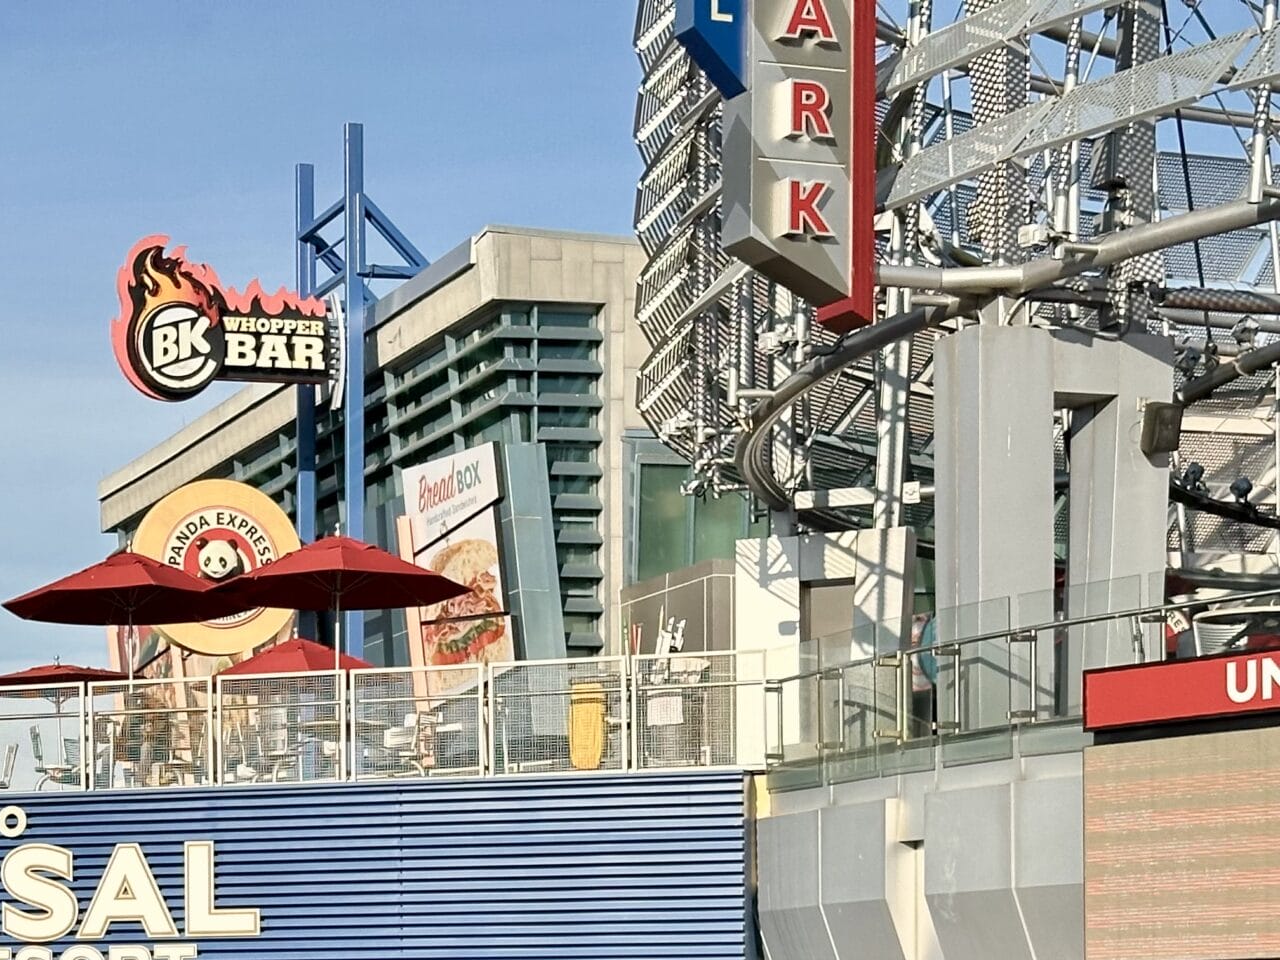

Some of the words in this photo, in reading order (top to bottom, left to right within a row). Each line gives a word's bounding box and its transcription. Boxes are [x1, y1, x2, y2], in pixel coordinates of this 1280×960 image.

[152, 316, 211, 368] BK
[222, 316, 324, 335] WHOPPER
[224, 333, 325, 370] BAR
[169, 515, 210, 566] PANDA
[216, 512, 272, 566] EXPRESS
[1226, 657, 1280, 703] UN
